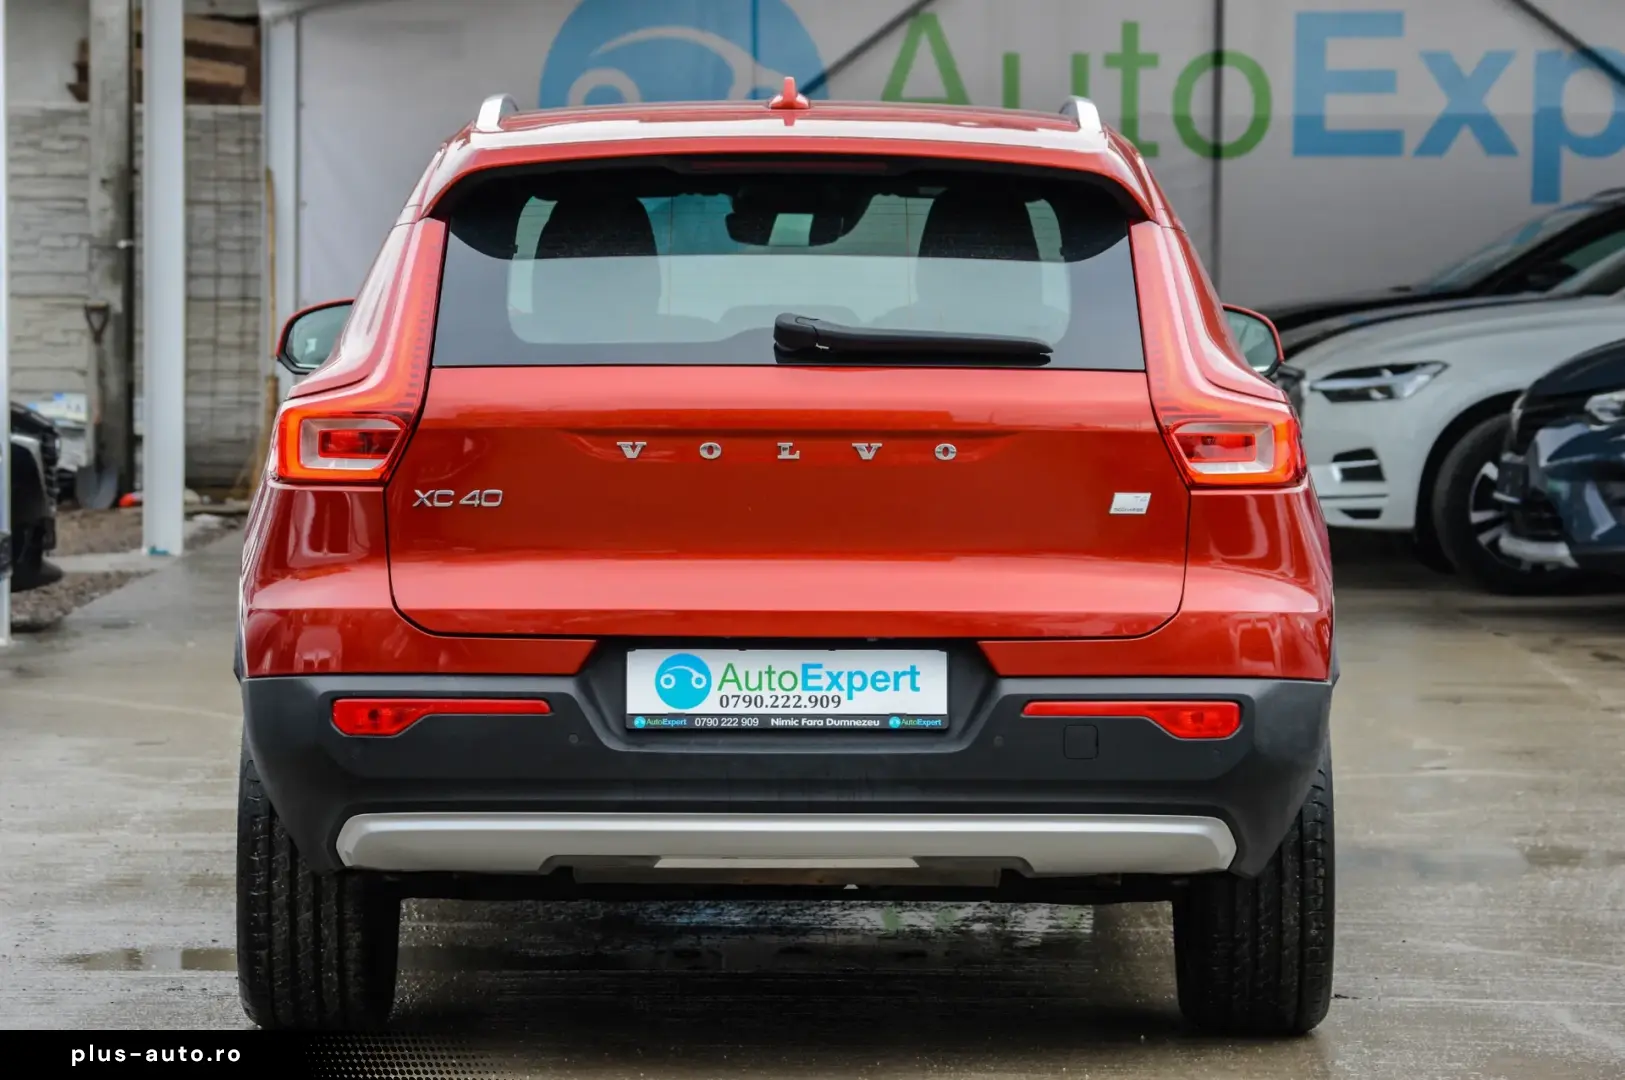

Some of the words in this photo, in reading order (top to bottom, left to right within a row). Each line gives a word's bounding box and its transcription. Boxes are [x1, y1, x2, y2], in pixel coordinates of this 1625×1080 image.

[616, 441, 959, 461] VOLVO
[717, 662, 921, 701] AutoExpert
[719, 694, 842, 710] 0790.222.909
[646, 718, 687, 727] AutoExpert
[694, 717, 719, 727] 0790
[720, 717, 739, 727] 222
[740, 717, 760, 727] 909
[770, 717, 799, 727] Nimic
[801, 717, 825, 727] Fara
[826, 717, 881, 728] Dumnezeu
[901, 718, 942, 727] AutoExpert
